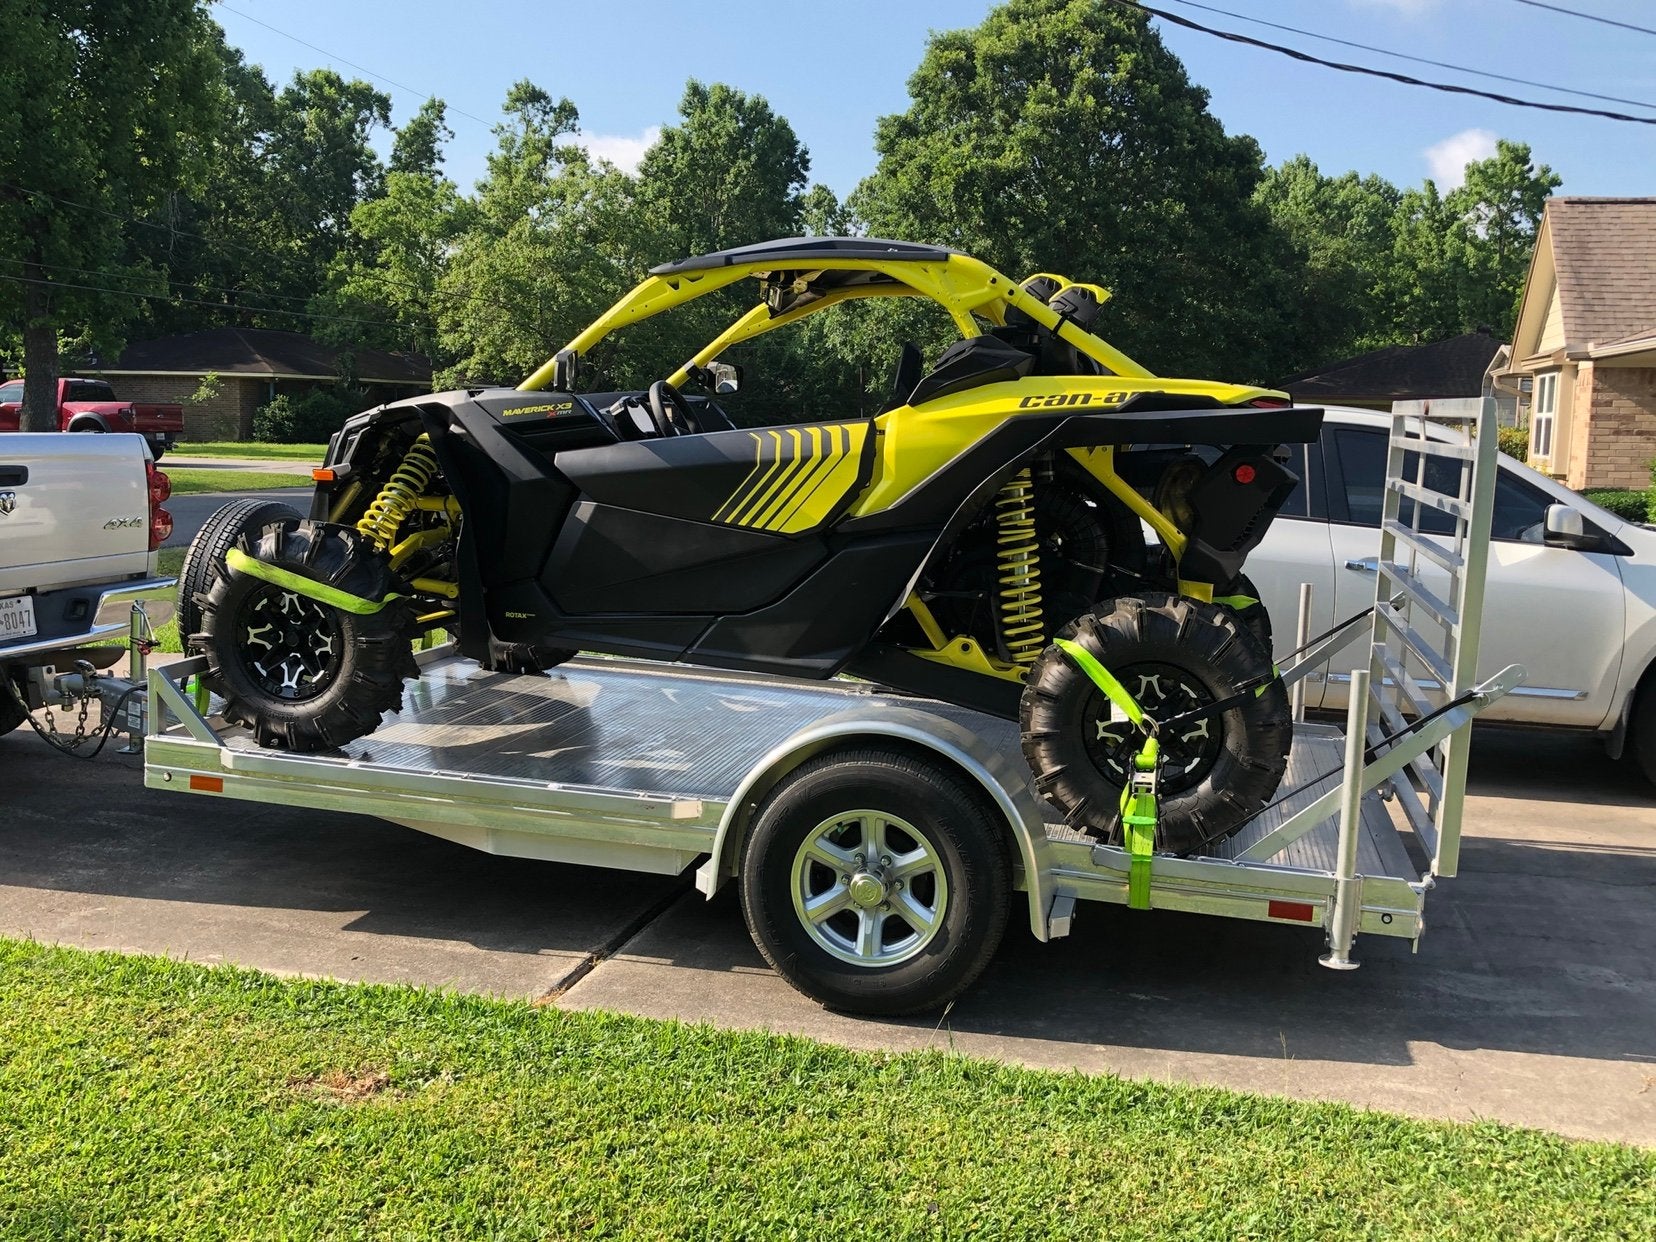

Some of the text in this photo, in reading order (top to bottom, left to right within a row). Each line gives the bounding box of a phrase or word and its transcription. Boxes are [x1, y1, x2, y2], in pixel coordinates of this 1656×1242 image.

[502, 402, 573, 416] MAVERICK X3
[0, 601, 14, 610] XAS
[4, 610, 31, 631] 8047
